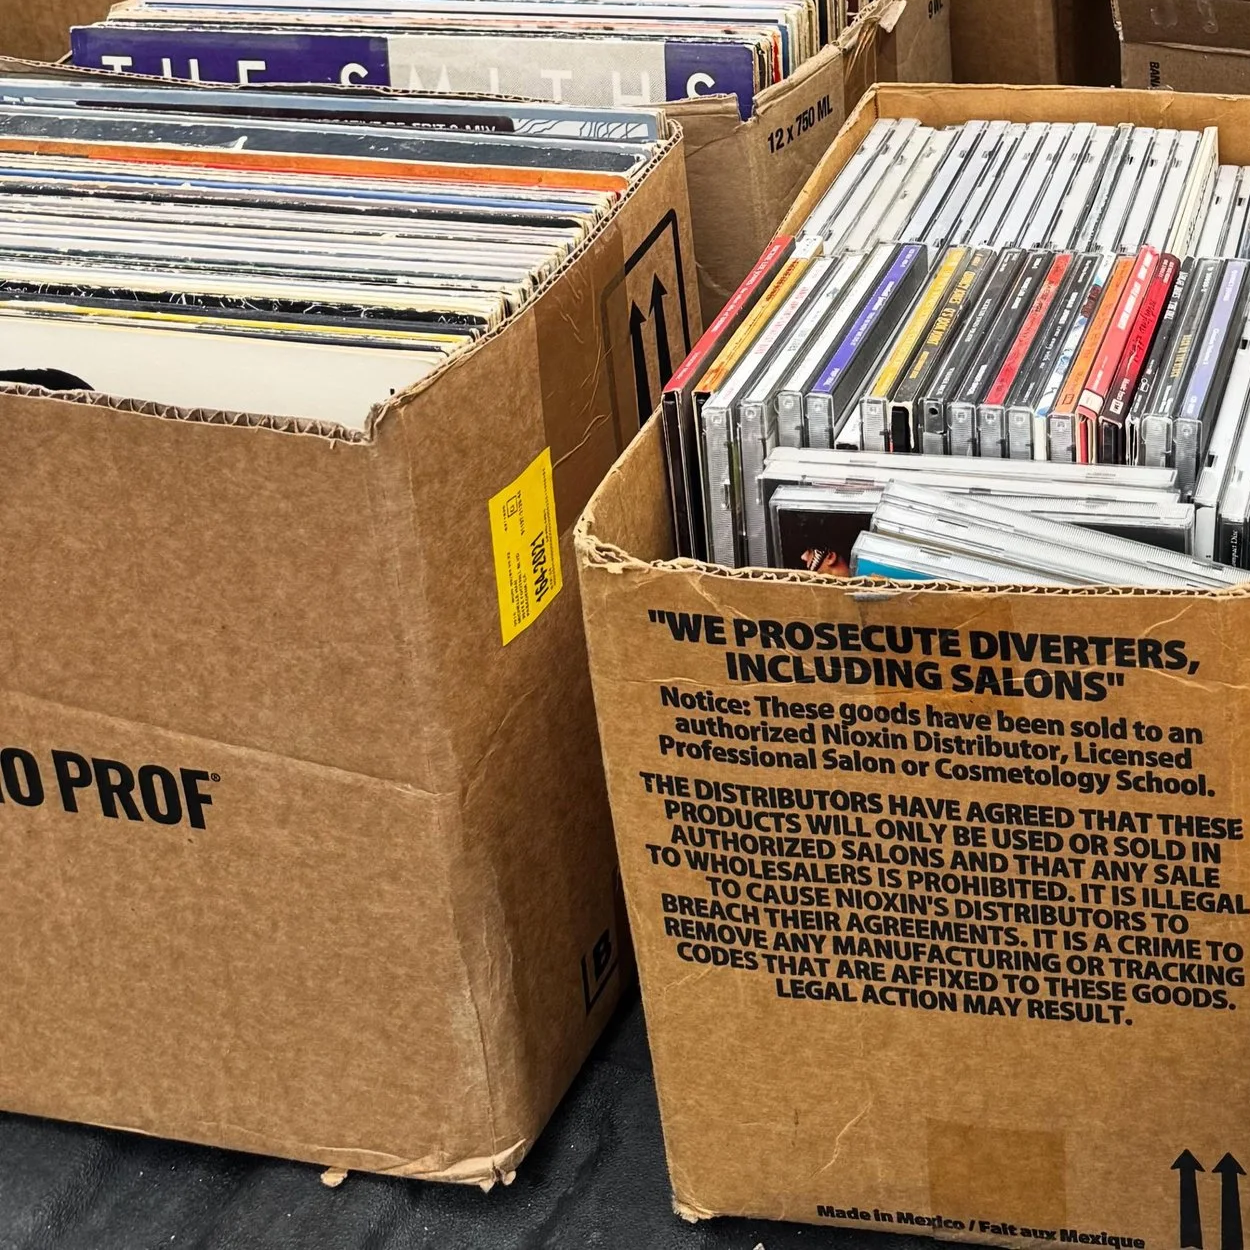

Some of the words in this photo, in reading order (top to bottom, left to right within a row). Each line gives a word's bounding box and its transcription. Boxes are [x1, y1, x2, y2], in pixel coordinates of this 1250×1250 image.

[1150, 61, 1160, 87] BAN
[768, 128, 784, 153] 12
[796, 106, 815, 136] 750
[817, 95, 833, 121] ML
[531, 530, 549, 603] 164-2021
[647, 609, 727, 646] "WE
[732, 618, 962, 658] PROSECUTE
[968, 630, 1200, 675] DIVERTERS,
[725, 651, 943, 691] INCLUDING
[950, 663, 1125, 702] SALONS"
[660, 685, 751, 717] Notice:
[753, 695, 835, 720] These
[839, 701, 922, 731] goods
[925, 704, 992, 732] have
[996, 709, 1065, 737] been
[1070, 716, 1128, 740] sold
[1132, 720, 1163, 743] to
[1168, 726, 1204, 745] an
[675, 716, 817, 745] authorized
[821, 723, 908, 750] Nioxin
[913, 730, 1069, 765] Distributor,
[1074, 741, 1193, 770] Licensed
[658, 734, 817, 770] Professional
[821, 748, 896, 775] Salon
[901, 759, 930, 777] or
[934, 757, 1111, 795] Cosmetology
[1115, 769, 1216, 798] School.
[639, 771, 691, 798] THE
[693, 778, 884, 815] DISTRIBUTORS
[888, 794, 962, 822] HAVE
[965, 801, 1075, 829] AGREED
[1078, 808, 1153, 834] THAT
[1156, 813, 1244, 841] THESE
[664, 799, 802, 834] PRODUCTS
[805, 813, 872, 838] WILL
[875, 818, 948, 845] ONLY
[952, 825, 987, 848] BE
[991, 827, 1064, 853] USED
[1068, 833, 1109, 857] OR
[1113, 836, 1186, 861] SOLD
[1191, 841, 1221, 865] IN
[645, 843, 681, 868] TO
[683, 849, 873, 886] WHOLESALERS
[877, 867, 903, 889] IS
[906, 870, 1076, 903] PROHIBITED.
[1080, 883, 1106, 905] IT
[1111, 885, 1137, 907] IS
[670, 824, 836, 860] AUTHORIZED
[841, 839, 945, 869] SALONS
[949, 849, 1009, 874] AND
[1012, 853, 1086, 879] THAT
[1090, 859, 1149, 884] ANY
[1153, 863, 1221, 889] SALE
[661, 892, 761, 926] BREACH
[763, 907, 842, 932] THEIR
[845, 912, 1028, 948] AGREEMENTS.
[1032, 928, 1058, 950] IT
[1063, 930, 1088, 952] IS
[1092, 932, 1113, 954] A
[1117, 934, 1202, 960] CRIME
[1205, 940, 1244, 964] TO
[705, 876, 742, 899] TO
[745, 882, 831, 907] CAUSE
[834, 888, 950, 917] NIOXIN'S
[954, 898, 1147, 932] DISTRIBUTORS
[1151, 912, 1189, 935] TO
[663, 916, 769, 950] REMOVE
[772, 931, 827, 955] ANY
[832, 935, 1062, 974] MANUFACTURING
[1065, 954, 1105, 977] OR
[1108, 957, 1245, 987] TRACKING
[676, 941, 759, 971] CODES
[761, 953, 831, 978] THAT
[836, 959, 887, 982] ARE
[891, 963, 999, 992] AFFIXED
[1002, 973, 1040, 996] TO
[1043, 976, 1128, 1002] THESE
[1131, 983, 1237, 1011] GOODS.
[775, 978, 858, 1003] LEGAL
[861, 984, 958, 1012] ACTION
[963, 993, 1023, 1017] MAY
[1026, 998, 1133, 1026] RESULT.
[816, 1204, 871, 1221] Made
[873, 1208, 893, 1223] in
[899, 1210, 965, 1231] Mexico
[978, 1220, 1017, 1236] Fait
[1020, 1226, 1056, 1241] aux
[1059, 1228, 1146, 1249] Mexique
